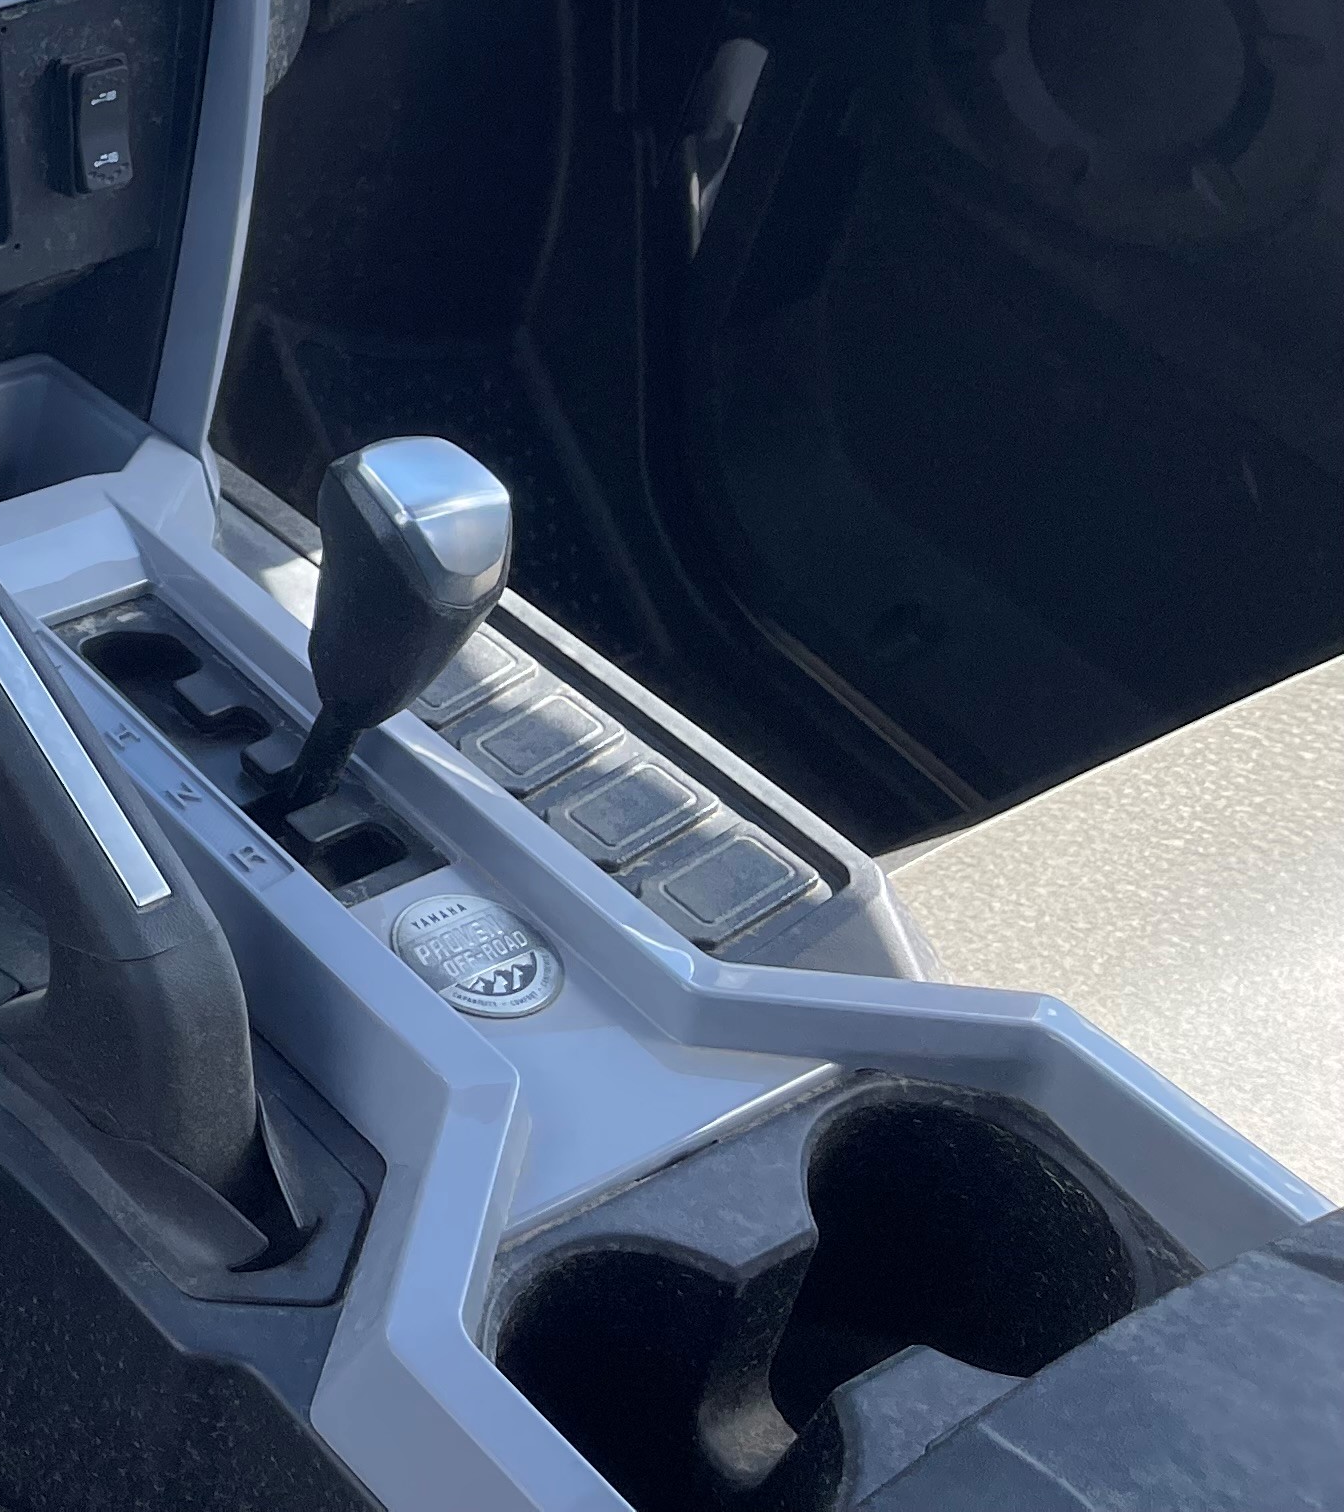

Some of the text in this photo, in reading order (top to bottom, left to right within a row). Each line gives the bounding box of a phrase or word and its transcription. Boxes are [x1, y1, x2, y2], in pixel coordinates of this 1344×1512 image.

[165, 782, 202, 810] N
[230, 846, 265, 872] R
[410, 903, 467, 930] YAMAHA
[413, 913, 504, 966] PROVEN
[443, 930, 528, 977] OFF-ROAD
